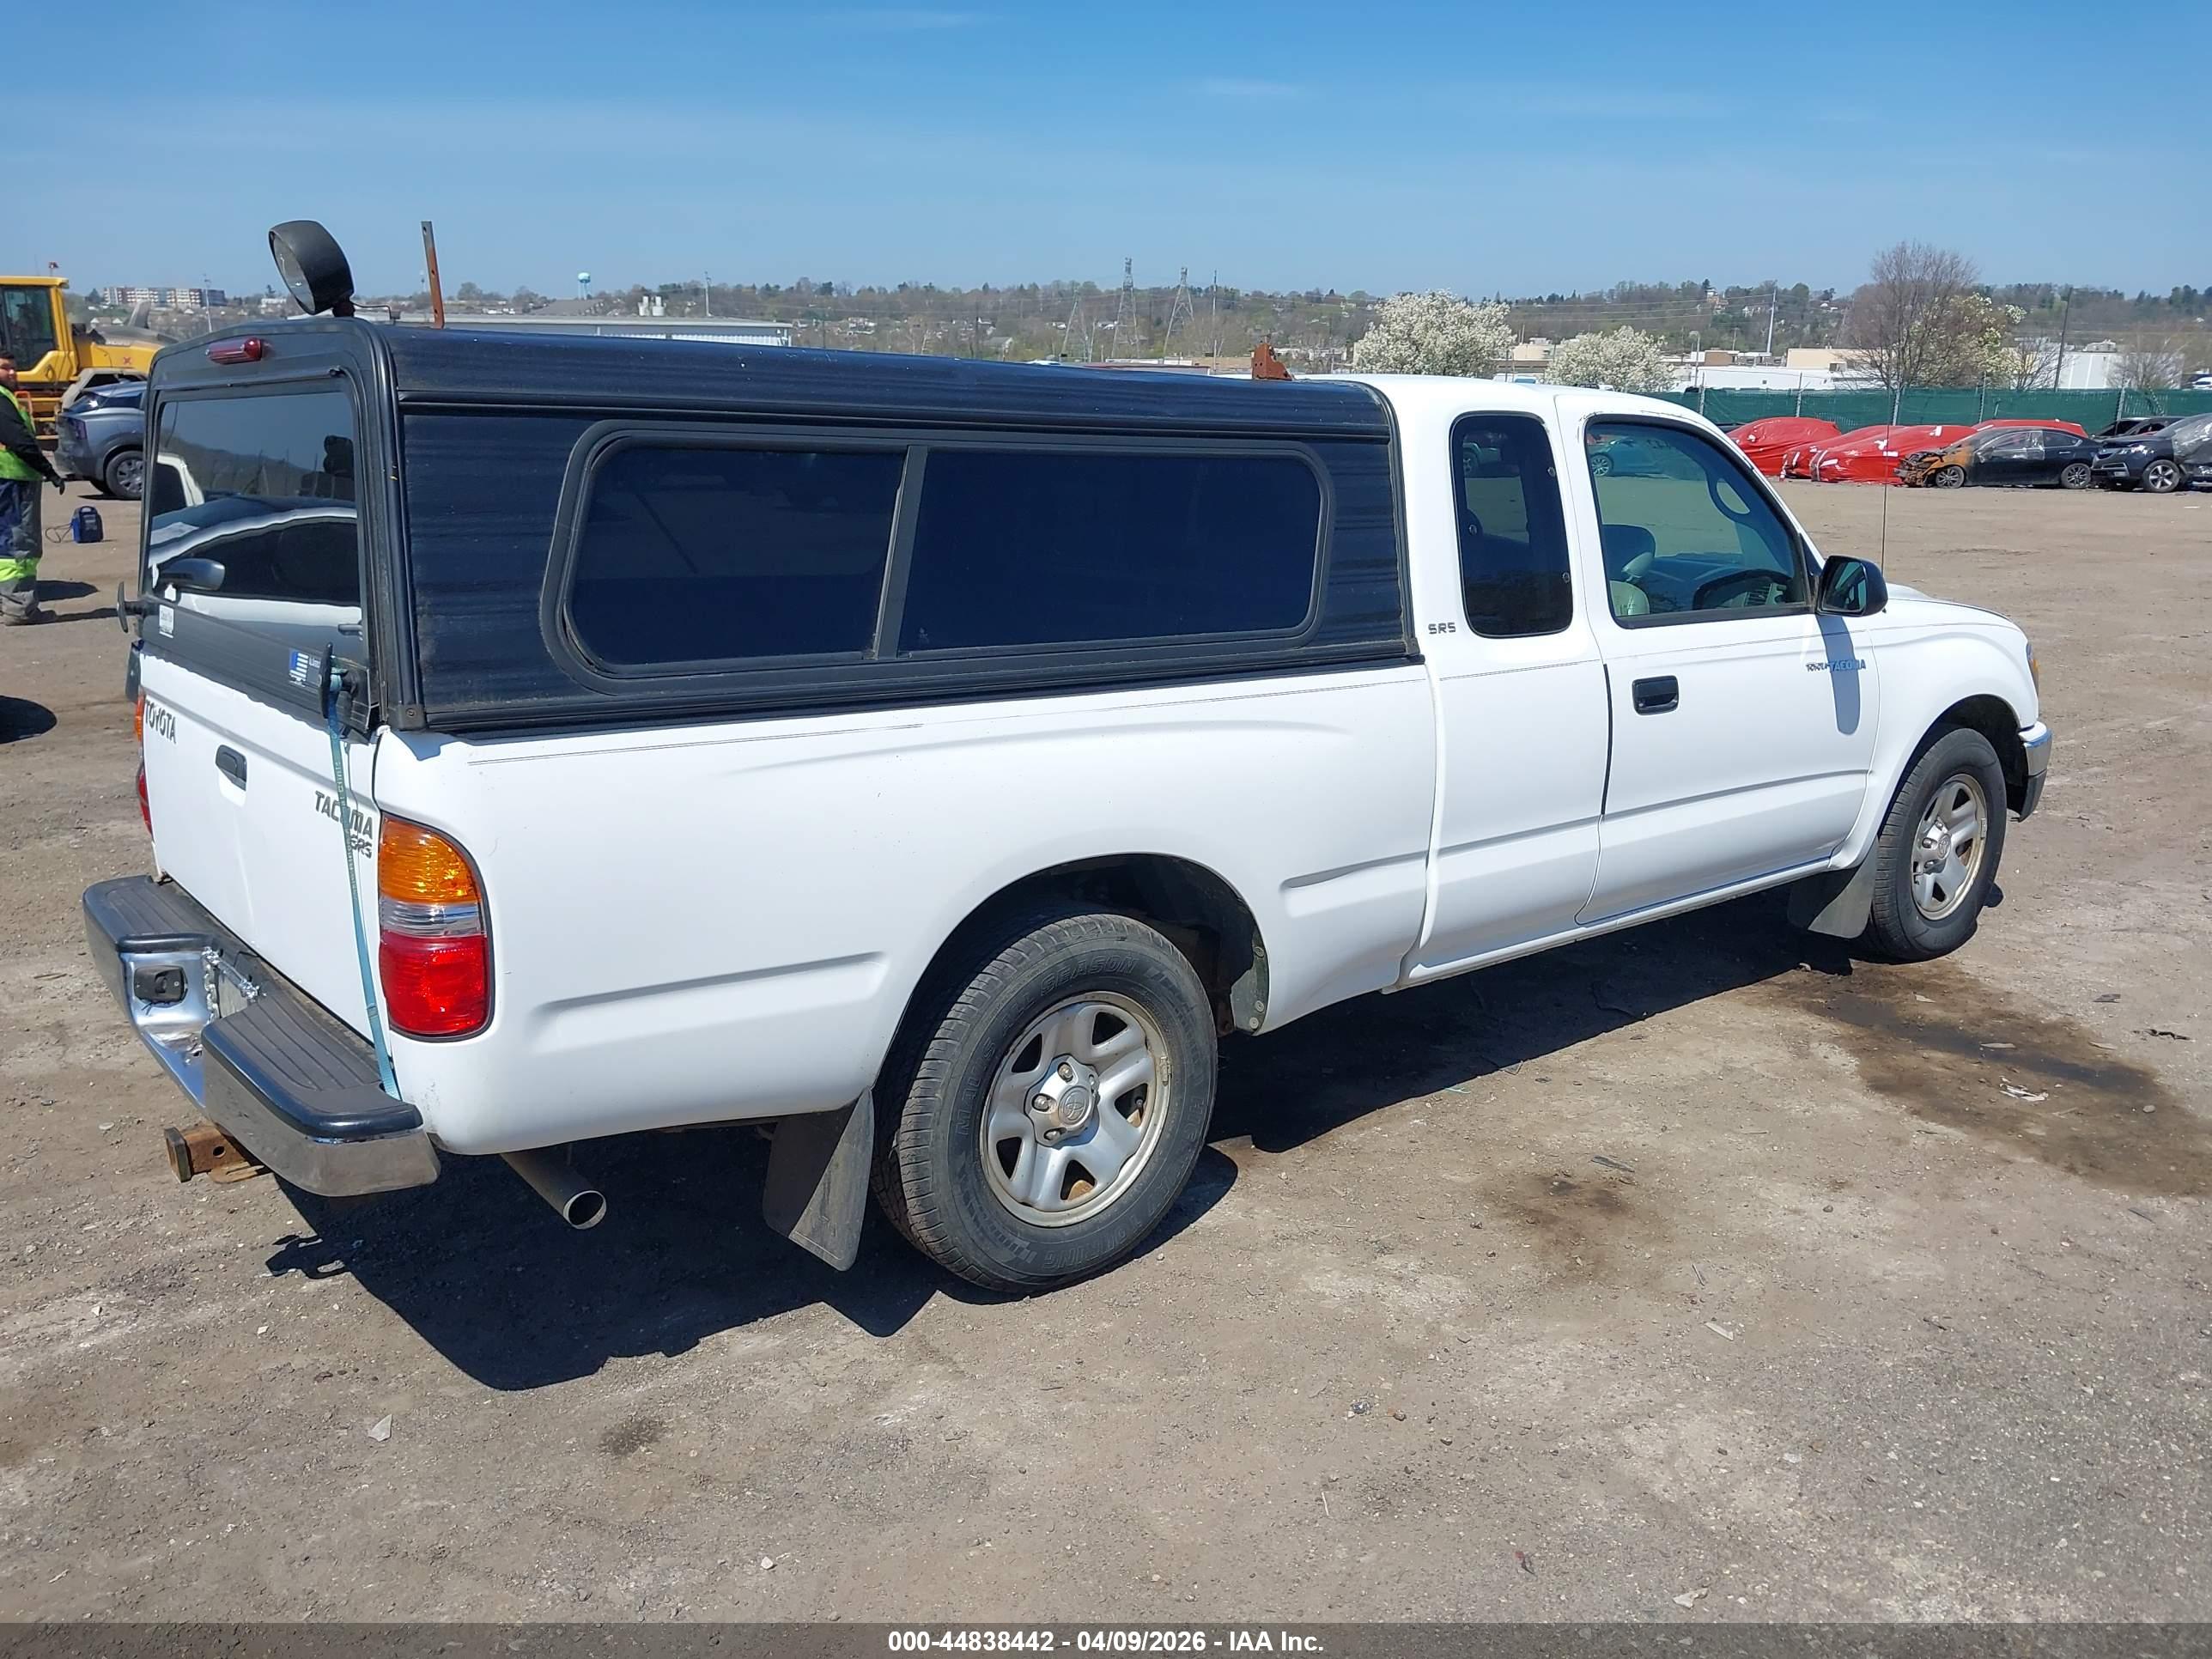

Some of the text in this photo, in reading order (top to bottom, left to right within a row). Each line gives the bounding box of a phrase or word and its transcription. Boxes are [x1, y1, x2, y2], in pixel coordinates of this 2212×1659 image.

[1428, 623, 1456, 635] SR5
[144, 699, 177, 744] TOYOTA
[314, 790, 374, 840] TACMA
[1040, 955, 1140, 997] SEASON
